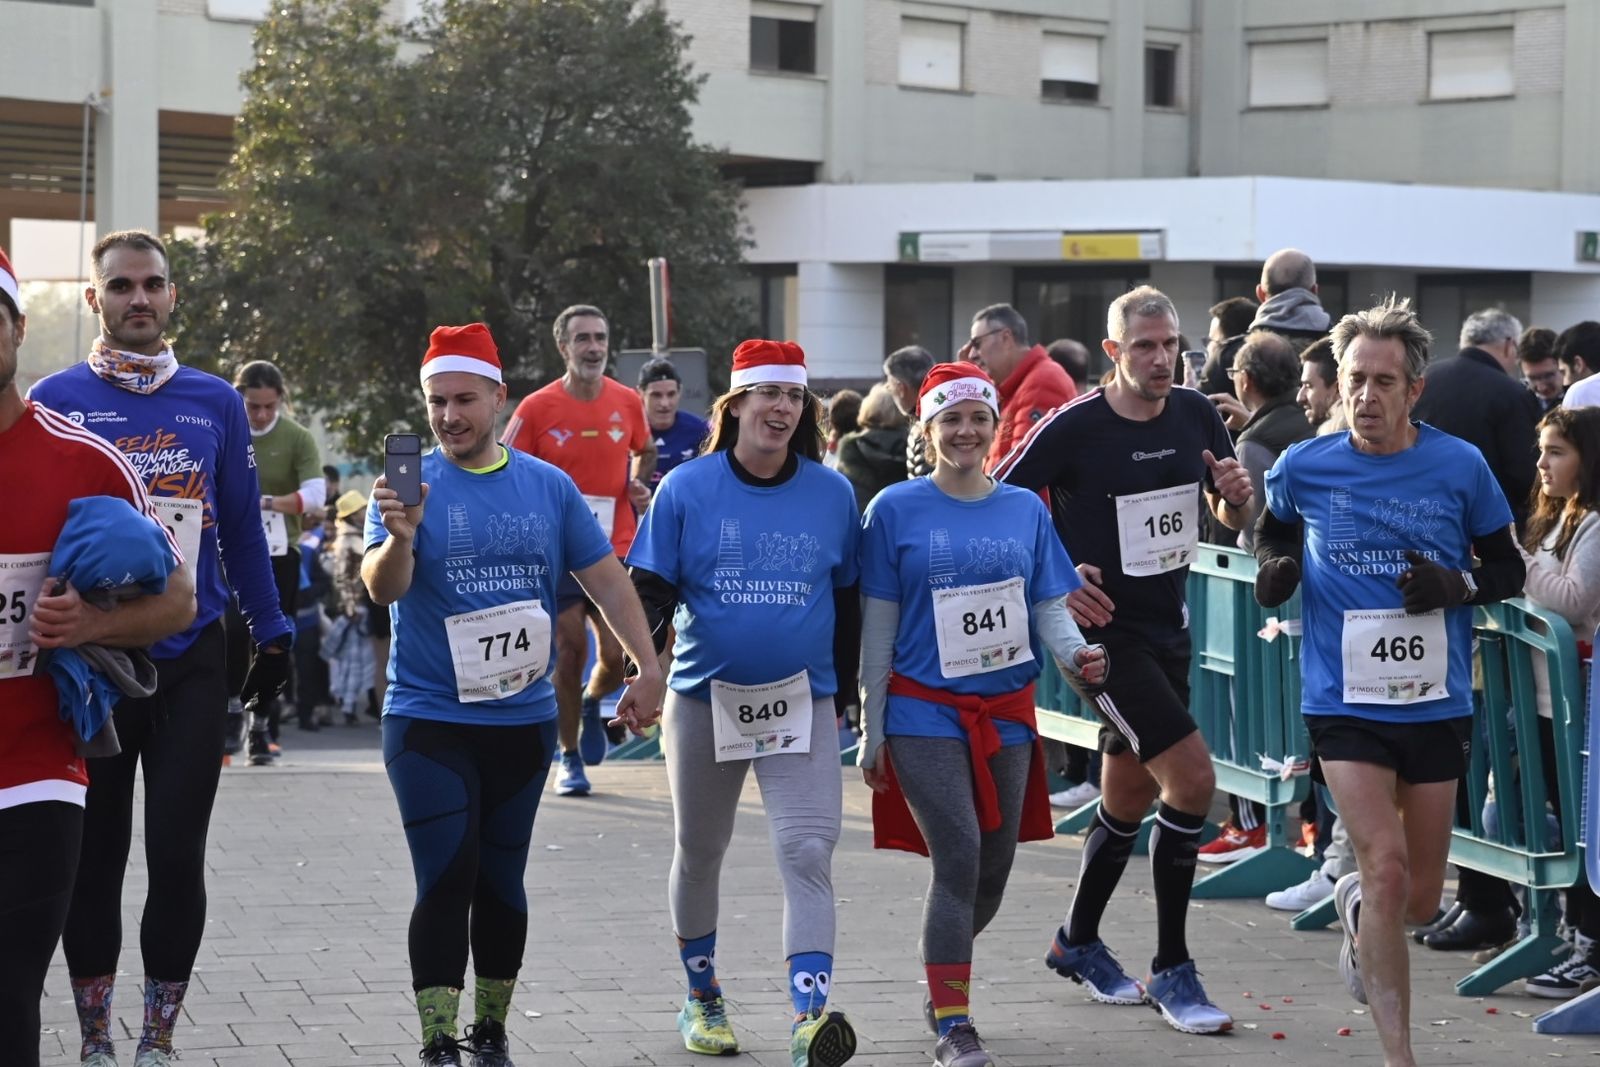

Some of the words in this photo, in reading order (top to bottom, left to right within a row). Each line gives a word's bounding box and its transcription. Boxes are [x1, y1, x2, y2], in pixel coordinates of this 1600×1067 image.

[175, 414, 212, 428] OYSHO
[1132, 449, 1176, 461] Champion
[1144, 511, 1183, 538] 166
[1327, 542, 1355, 550] XXXIX
[445, 559, 473, 567] XXXIX
[1328, 551, 1358, 564] SAN
[446, 568, 477, 582] SAN
[480, 564, 549, 579] SILVESTRE
[456, 577, 541, 595] CORDOBESA
[714, 580, 743, 591] SAN
[746, 581, 812, 595] SILVESTRE
[928, 576, 953, 585] XXXIX
[721, 593, 806, 607] CORDOBESA
[962, 605, 1006, 636] 841
[478, 627, 531, 661] 774
[1371, 634, 1424, 662] 466
[952, 658, 979, 667] IMDECO
[470, 684, 498, 694] IMDECO
[739, 700, 788, 724] 840
[727, 742, 753, 751] IMDECO
